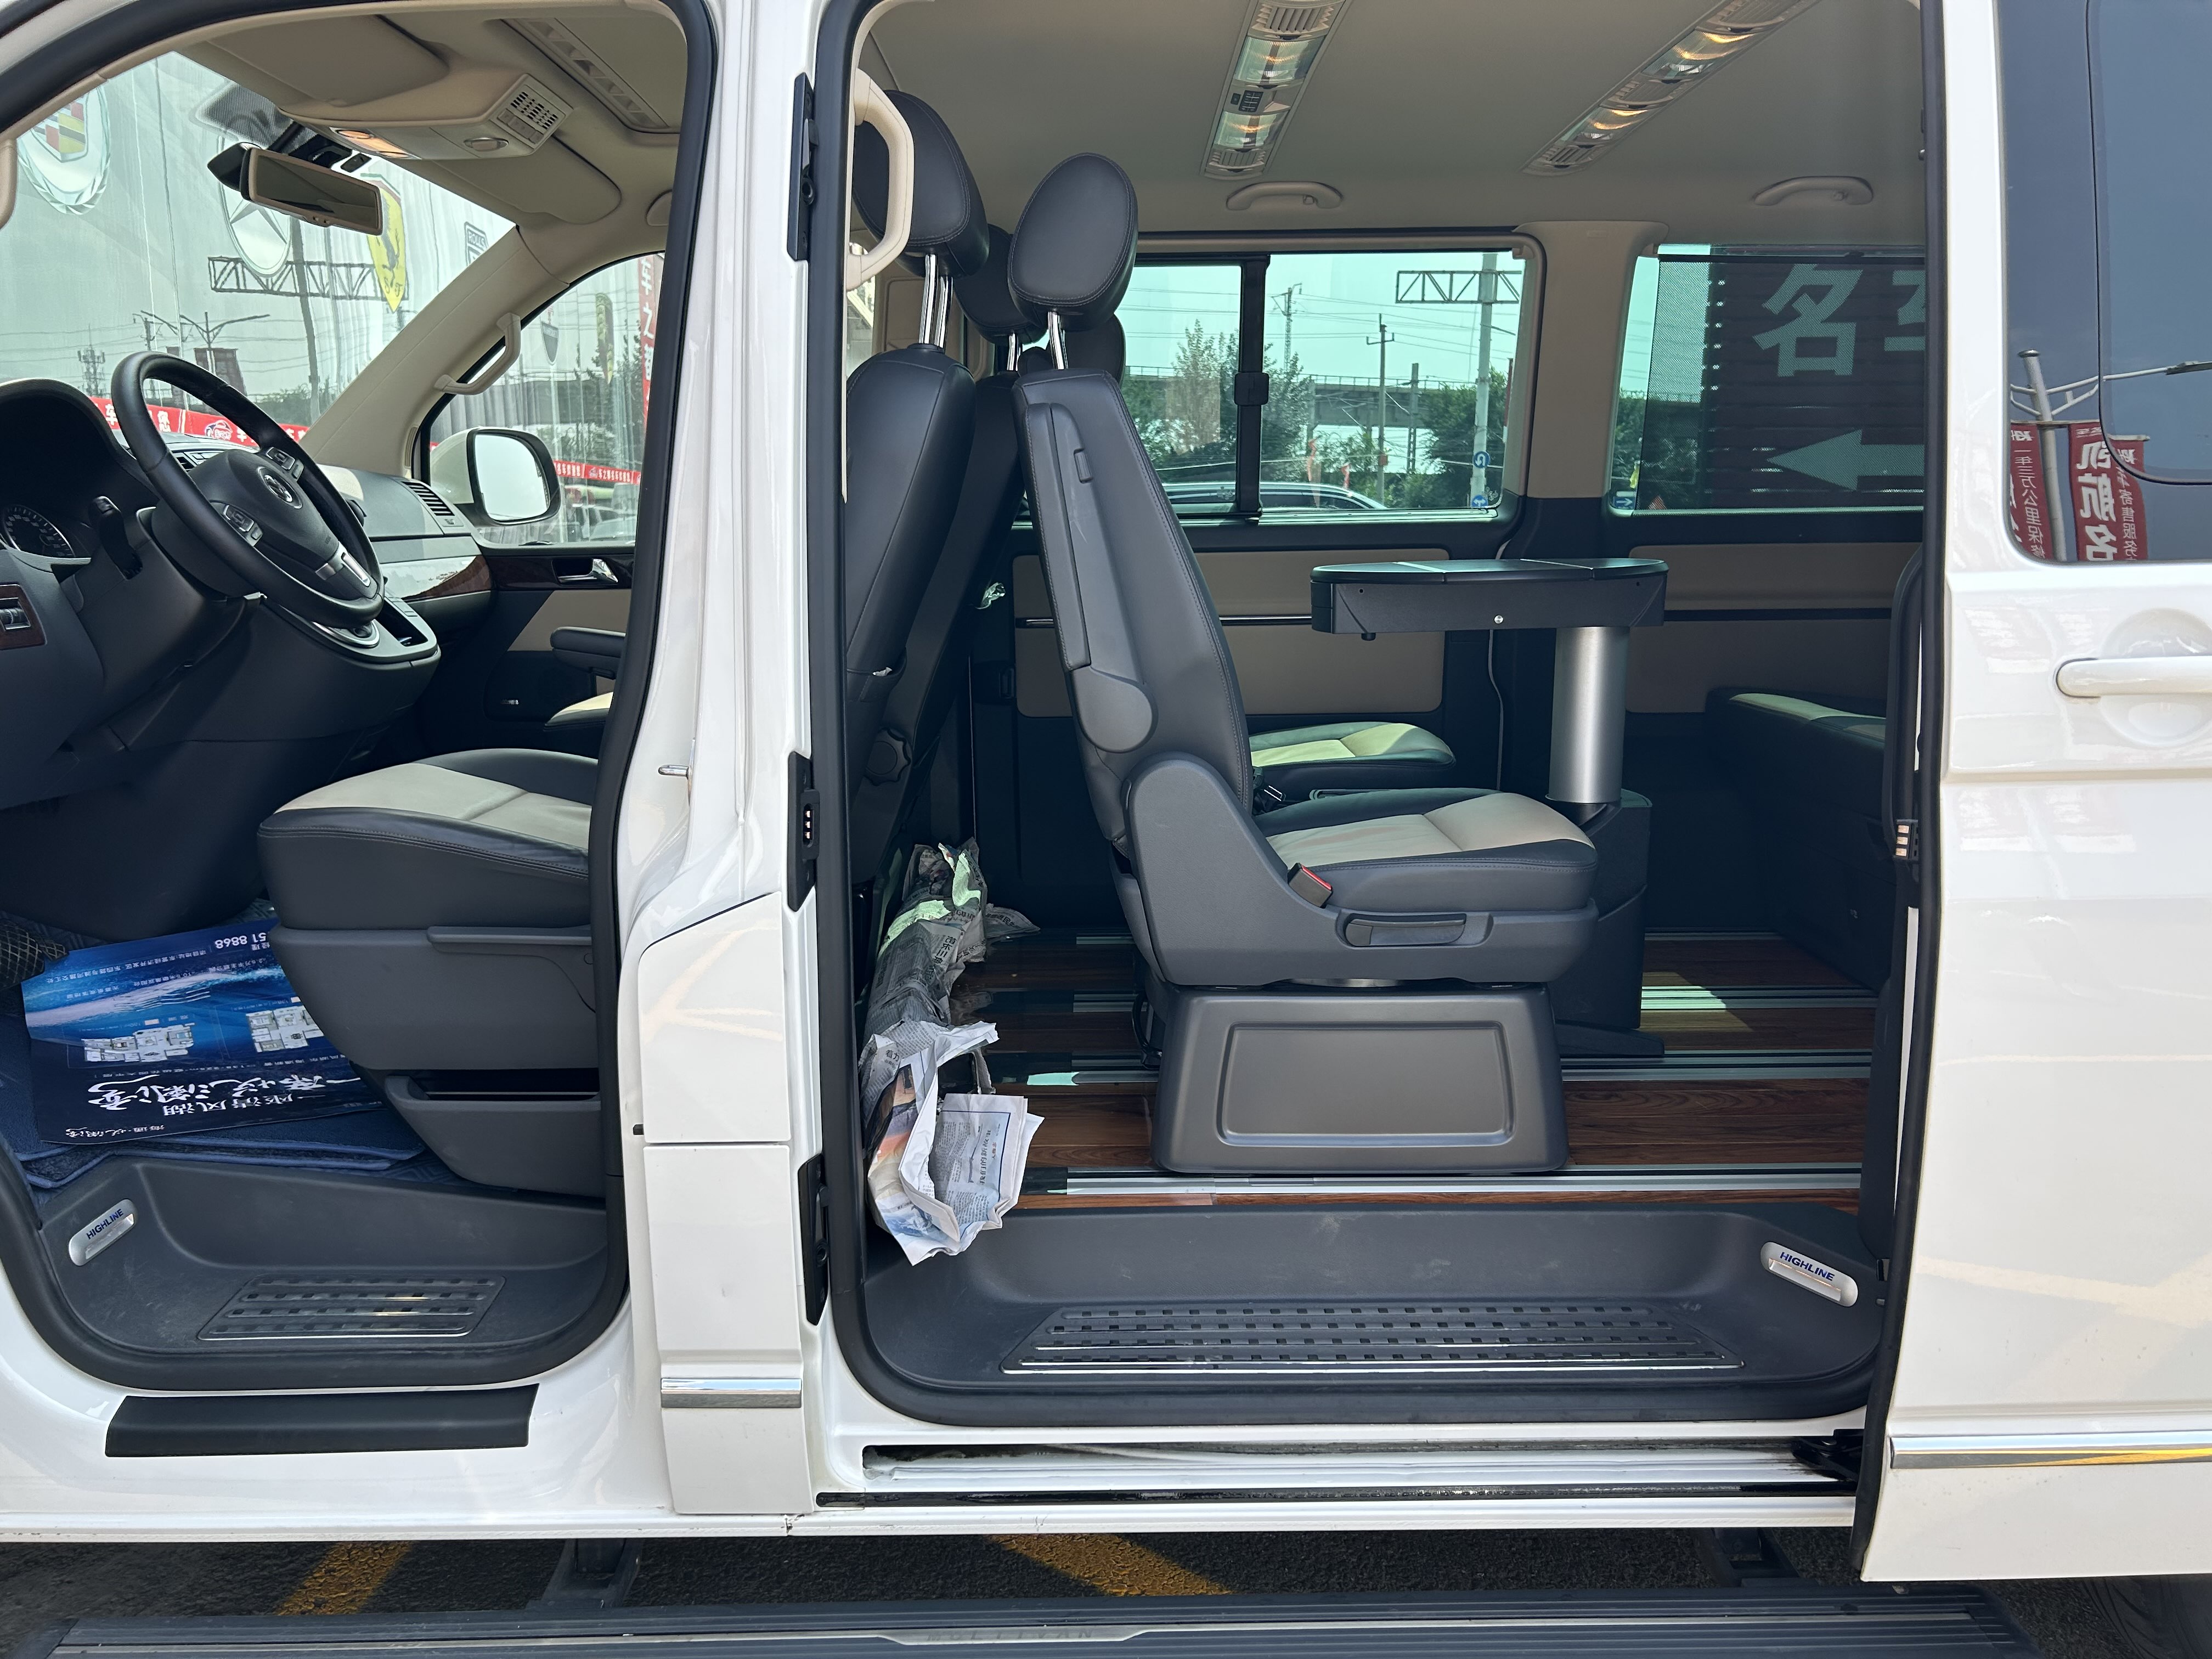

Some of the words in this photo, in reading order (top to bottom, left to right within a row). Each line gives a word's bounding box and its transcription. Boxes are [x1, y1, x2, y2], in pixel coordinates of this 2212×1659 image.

[215, 935, 247, 950] 8868
[85, 1207, 125, 1240] HIGHLINE
[1780, 1251, 1835, 1282] HIGHLINE
